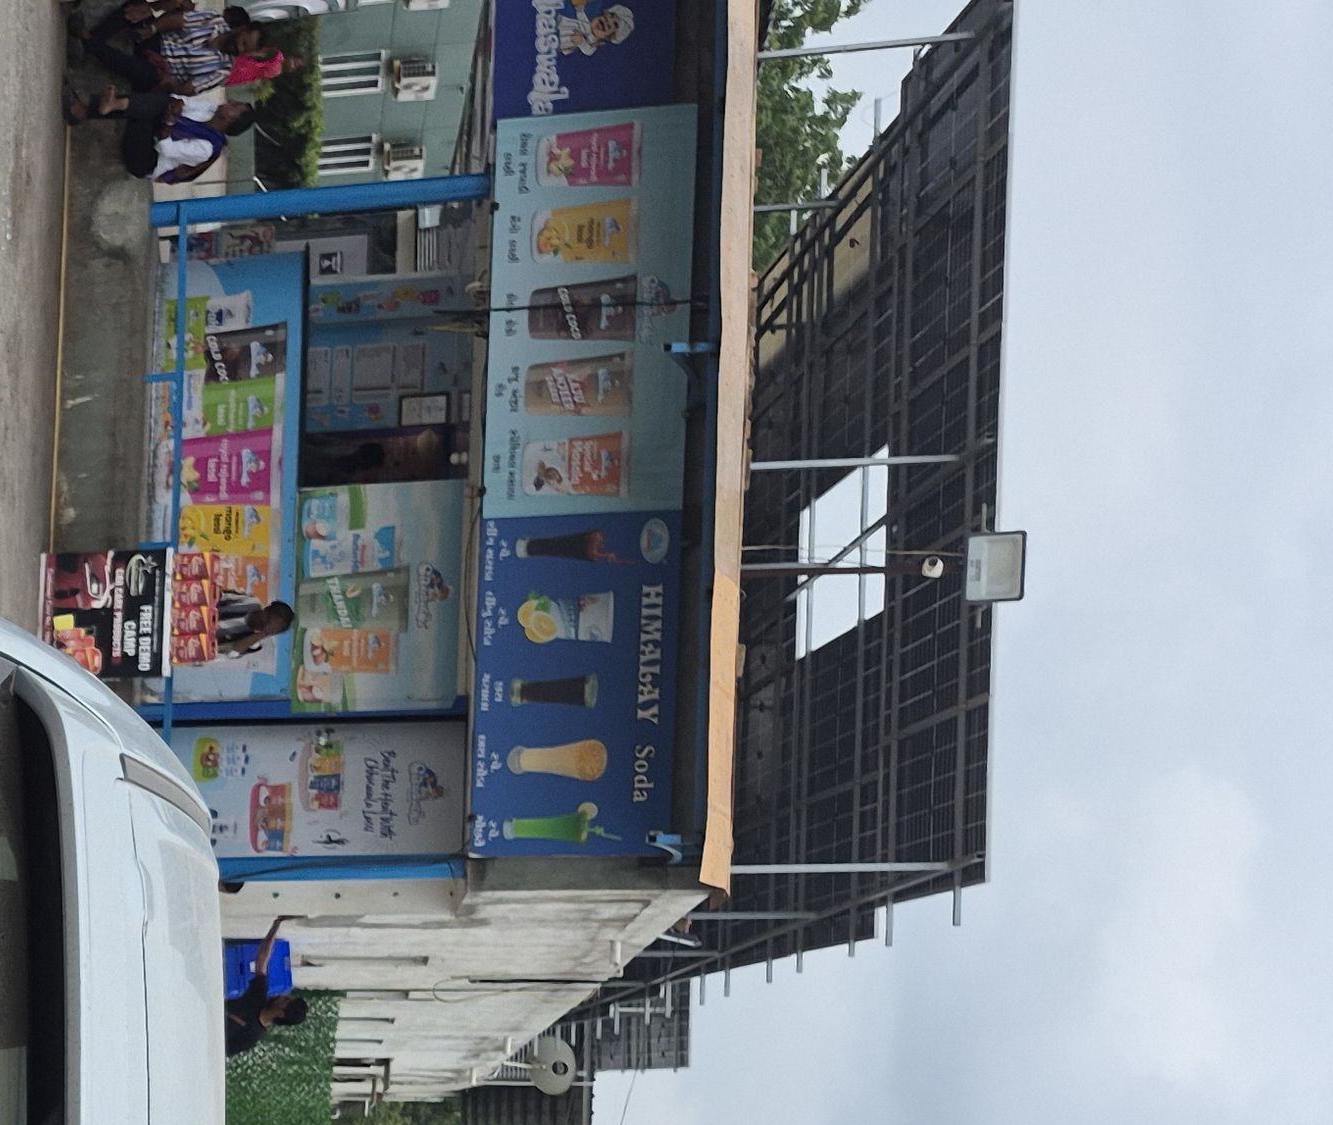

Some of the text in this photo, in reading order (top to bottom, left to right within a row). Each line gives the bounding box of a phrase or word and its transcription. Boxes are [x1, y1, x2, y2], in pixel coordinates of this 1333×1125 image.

[557, 287, 582, 340] COLD COCO
[206, 335, 223, 360] COLD
[222, 506, 233, 541] mango
[114, 568, 124, 586] CAR
[325, 577, 352, 628] THANDAI
[111, 611, 122, 657] PRODUCTS
[123, 621, 137, 657] CAMP
[137, 605, 153, 671] FREE DEMO
[633, 584, 663, 802] HIMALAY Soda
